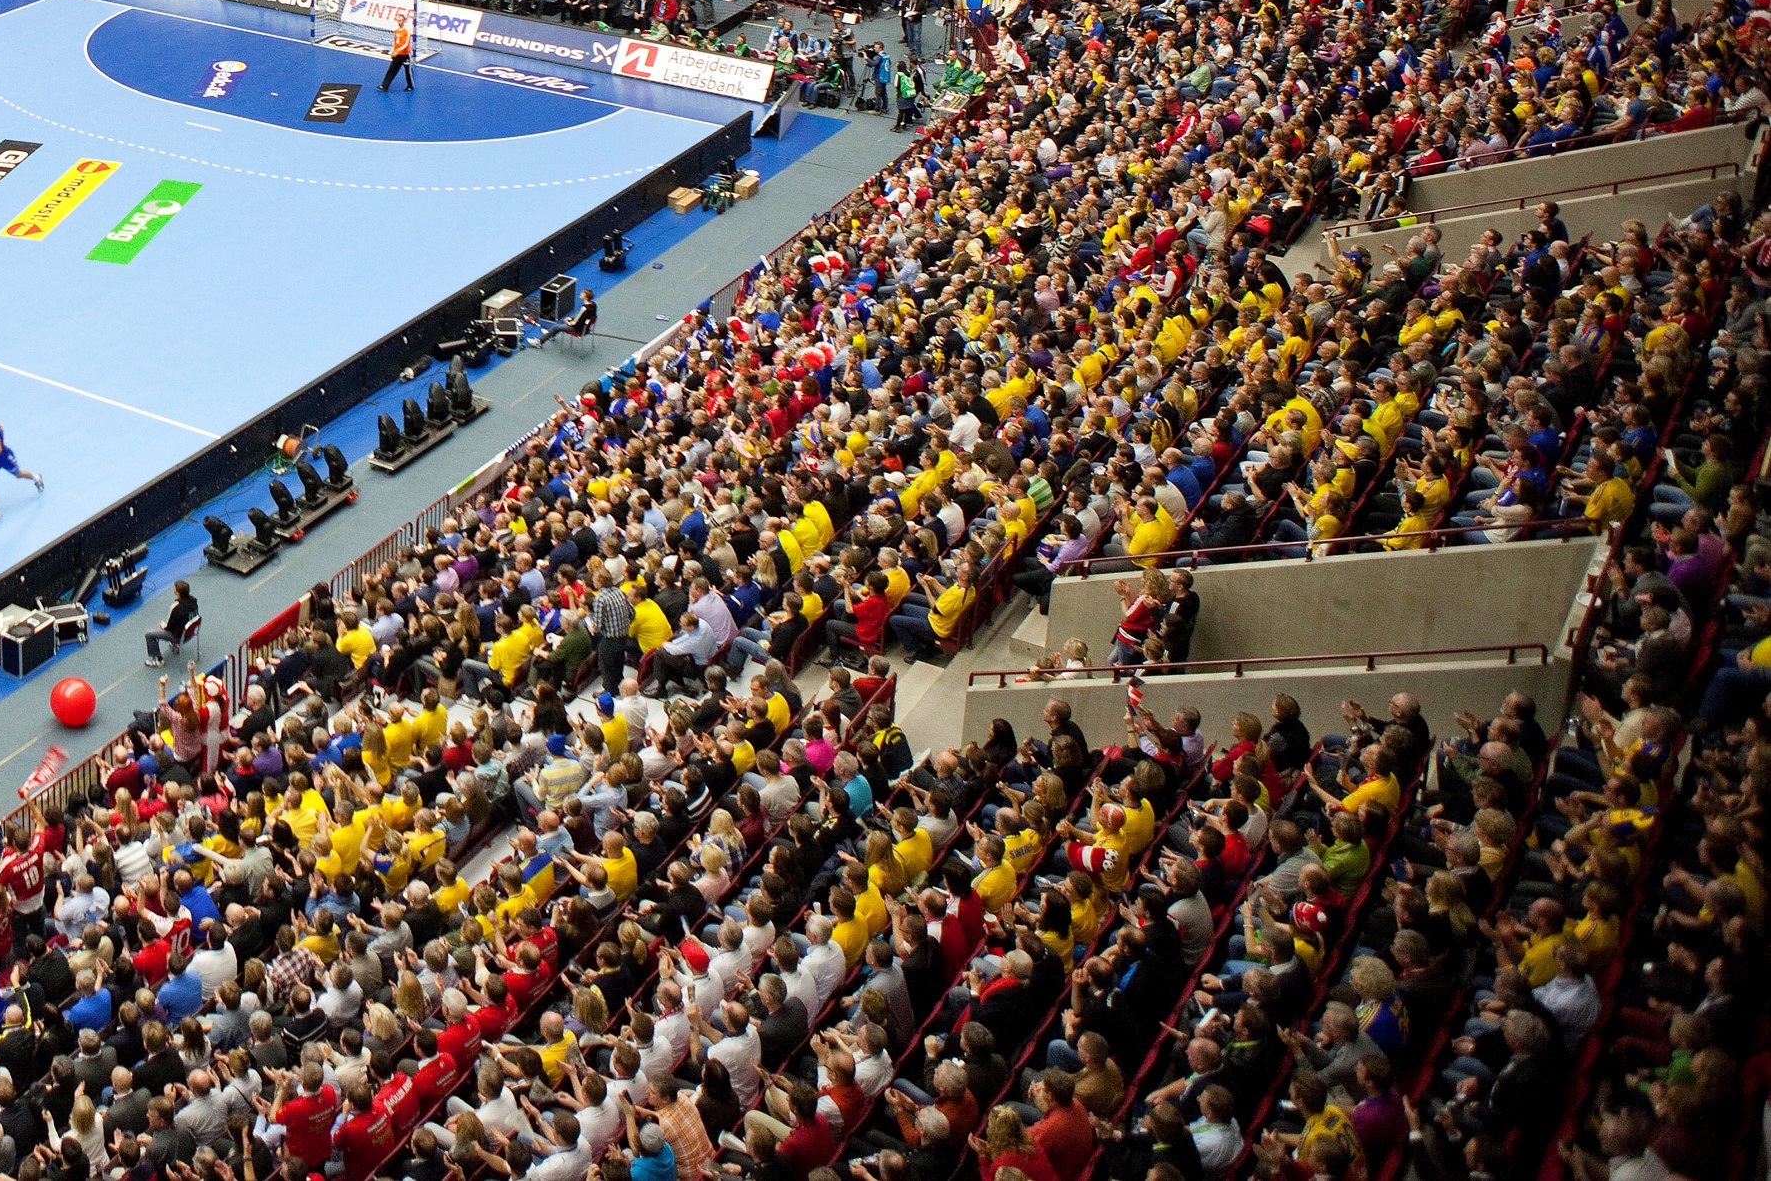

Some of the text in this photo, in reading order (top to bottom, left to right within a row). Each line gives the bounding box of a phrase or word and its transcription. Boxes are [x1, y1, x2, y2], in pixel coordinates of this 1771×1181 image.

[476, 31, 585, 60] GRUNDFOS
[477, 66, 591, 92] Gerflor
[668, 50, 761, 80] Arbejdernes
[664, 67, 745, 97] Landsbank
[107, 211, 159, 242] bring
[23, 864, 40, 890] 10
[170, 927, 191, 955] 10
